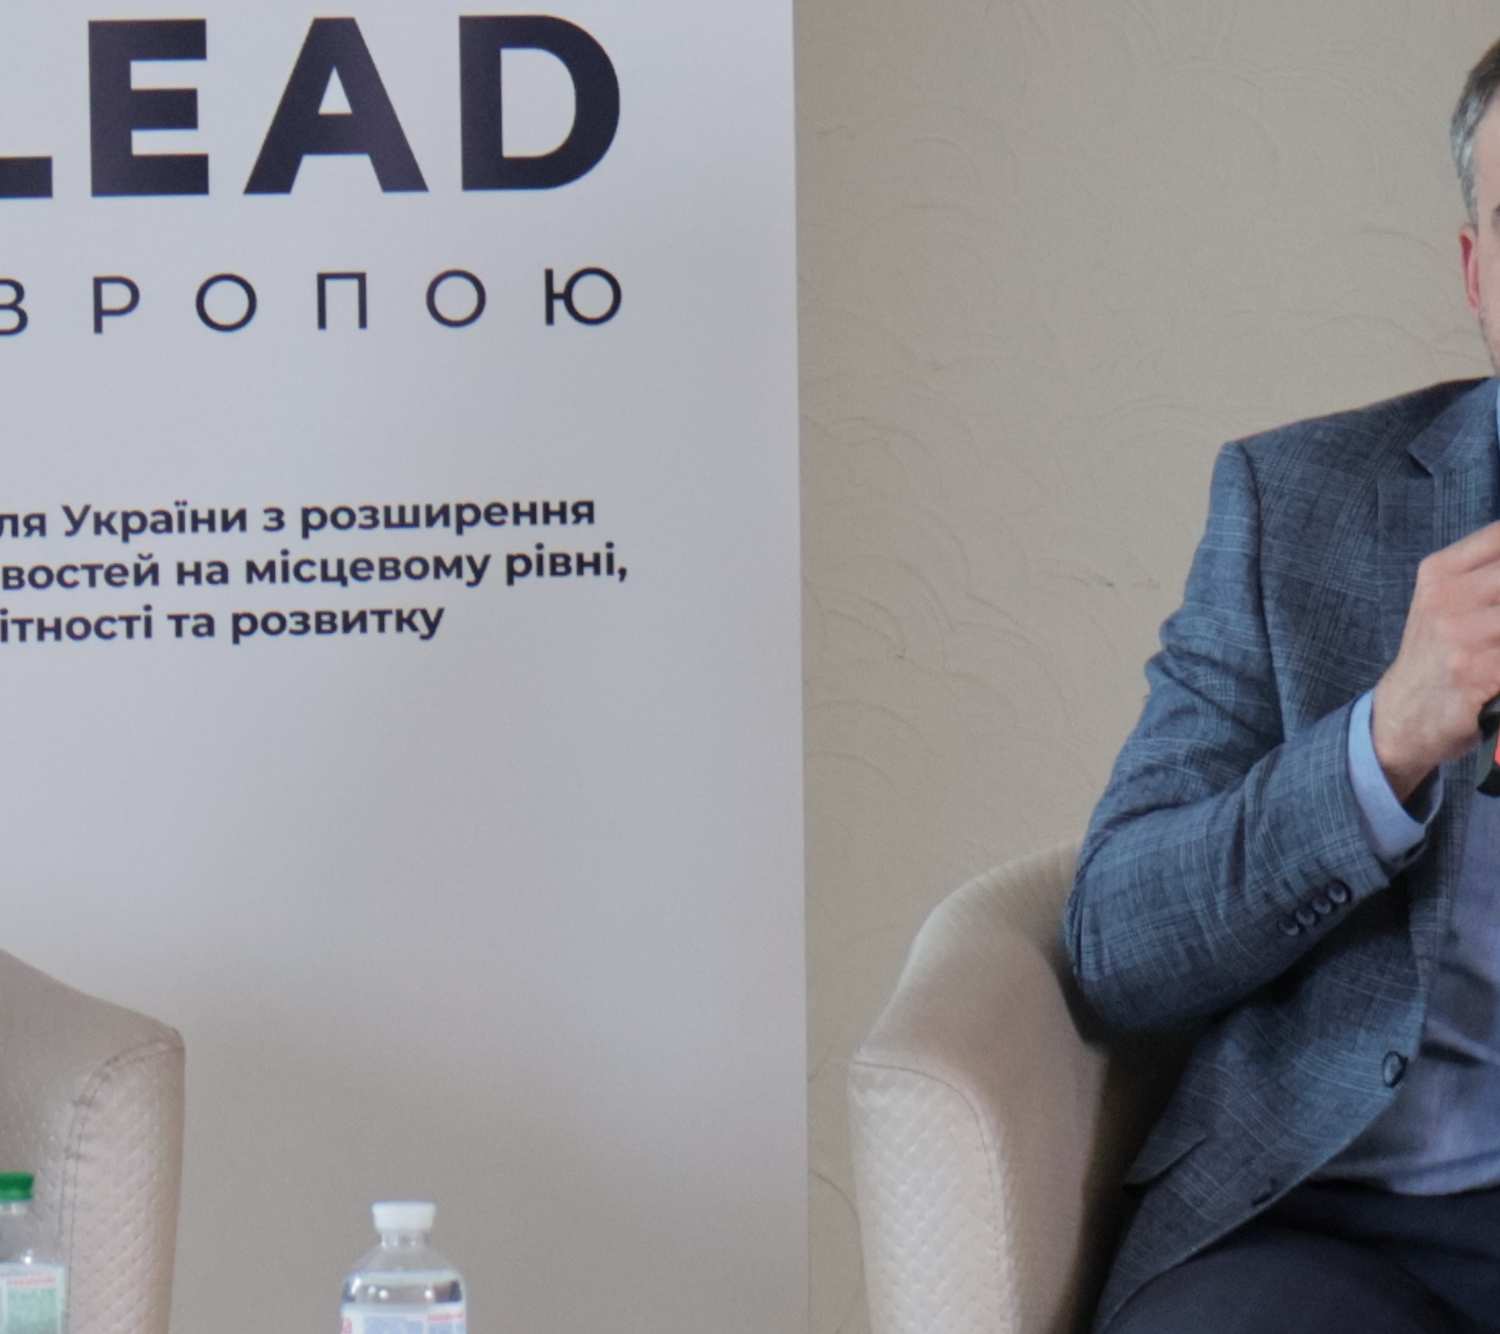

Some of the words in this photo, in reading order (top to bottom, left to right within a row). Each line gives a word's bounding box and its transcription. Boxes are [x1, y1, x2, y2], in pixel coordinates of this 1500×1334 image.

[61, 501, 248, 543] України
[262, 506, 286, 533] з
[300, 500, 595, 540] розширення
[176, 560, 230, 587] на
[245, 548, 491, 591] місцевому
[506, 542, 628, 587] рівні,
[167, 612, 216, 639] та
[231, 605, 445, 646] розвитку
